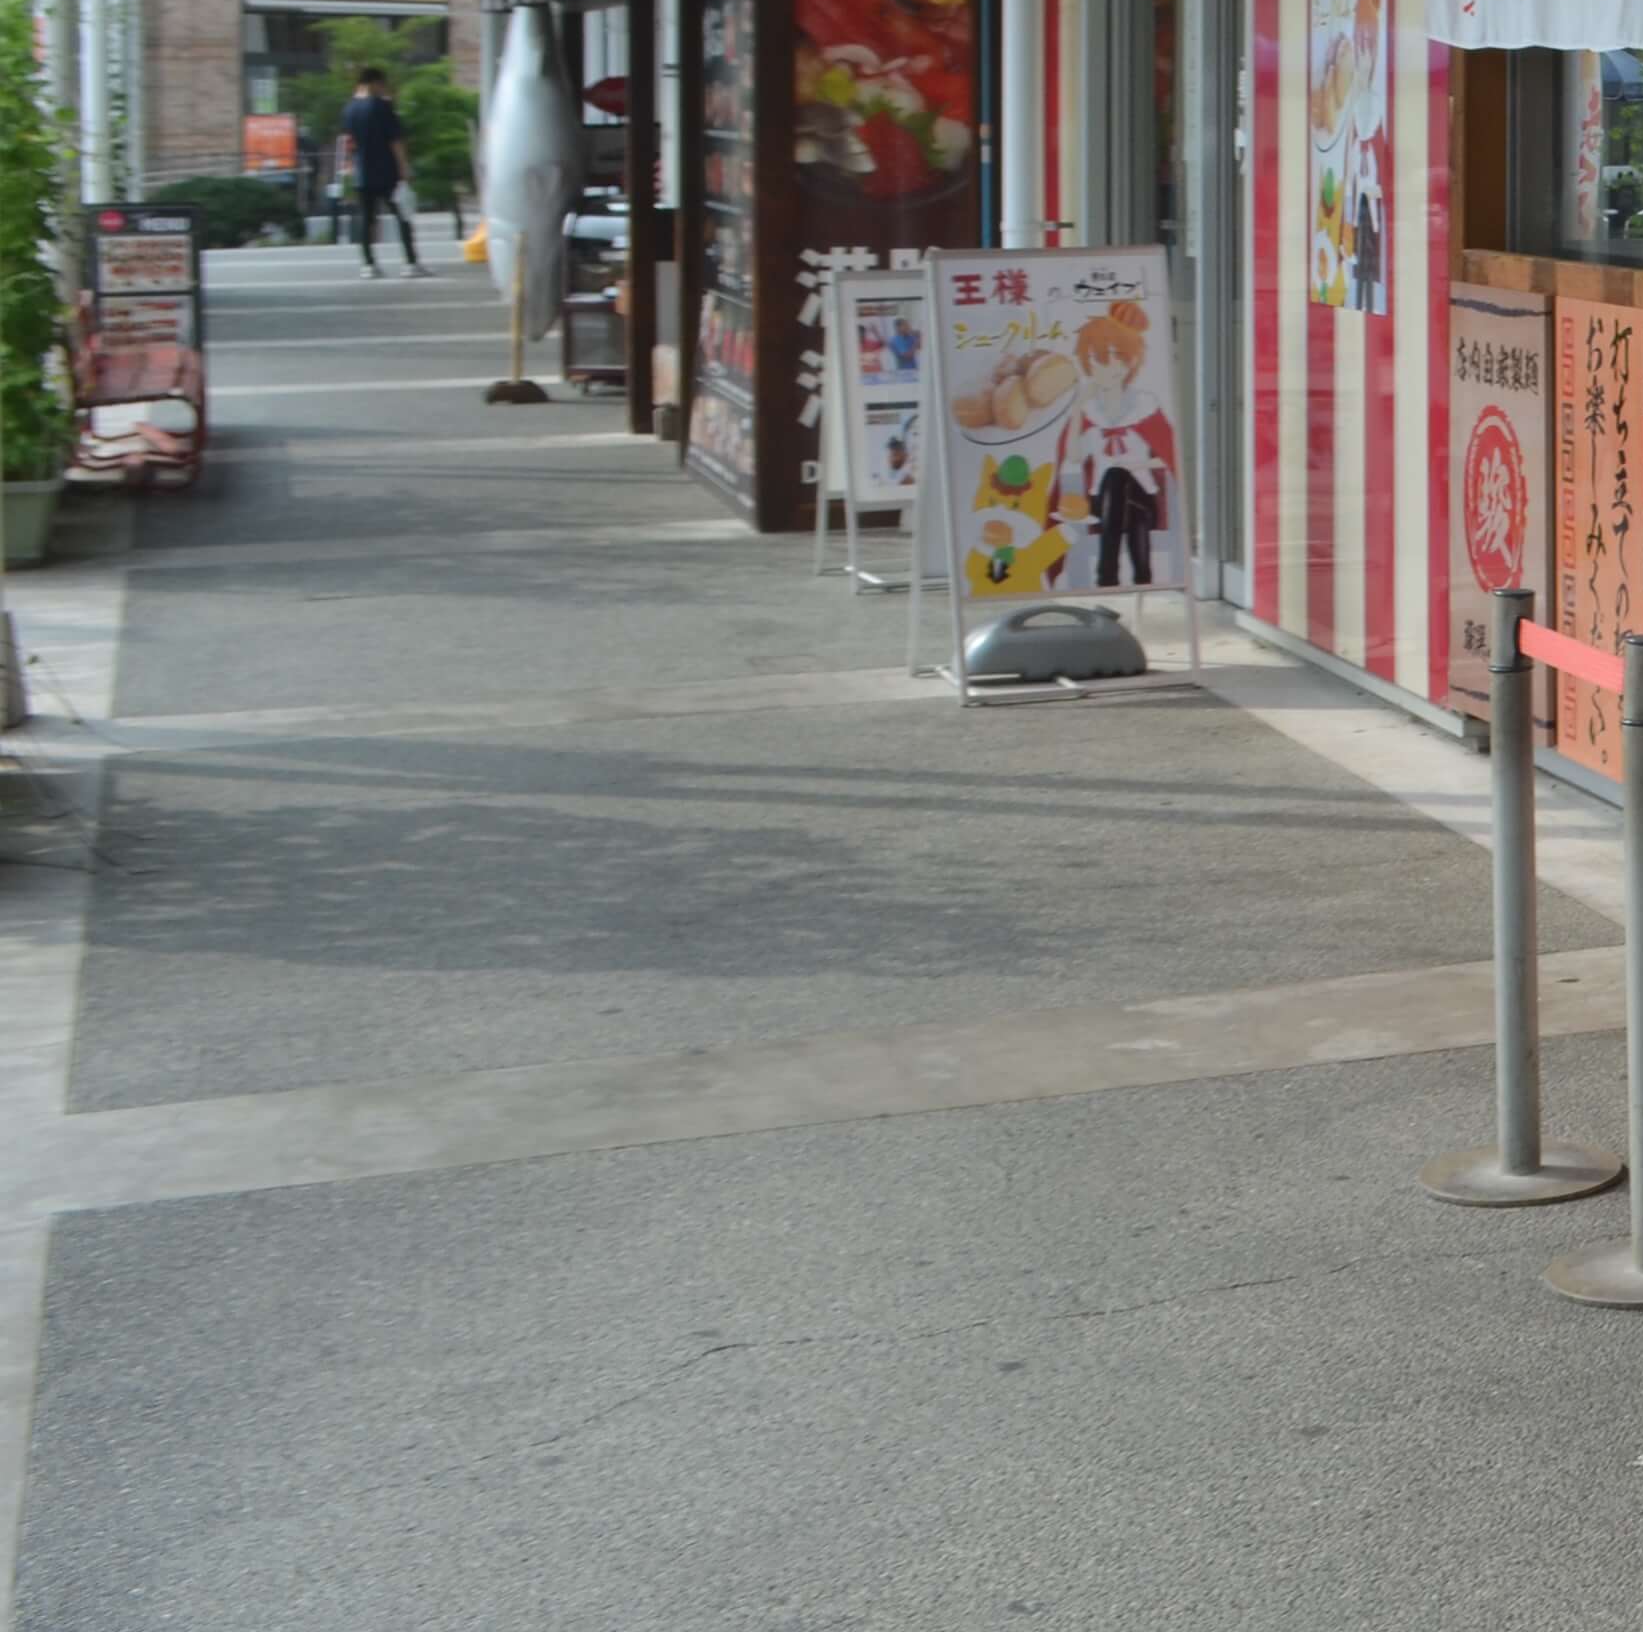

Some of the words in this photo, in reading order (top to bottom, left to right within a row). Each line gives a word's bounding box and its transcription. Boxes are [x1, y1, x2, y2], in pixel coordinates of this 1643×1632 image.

[952, 268, 1033, 306] 王様
[1453, 335, 1540, 395] 店内自家製麺
